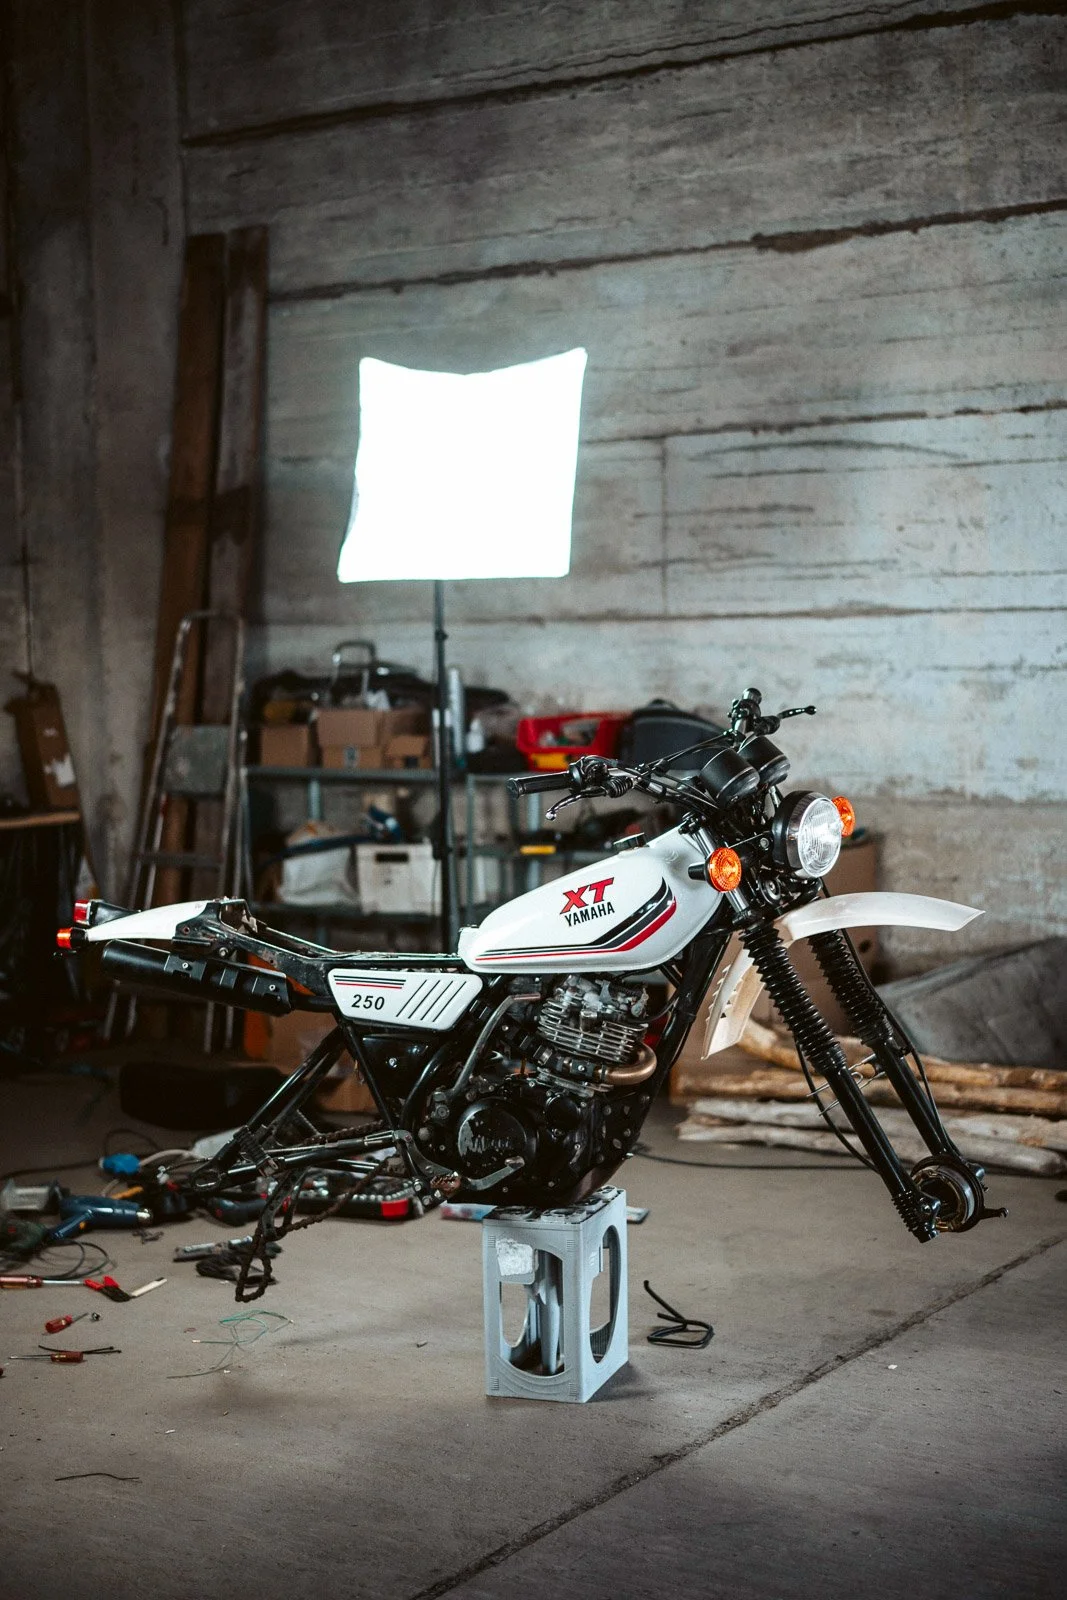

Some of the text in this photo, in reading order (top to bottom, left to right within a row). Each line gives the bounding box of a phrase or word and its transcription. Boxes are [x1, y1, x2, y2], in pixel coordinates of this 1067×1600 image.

[560, 877, 614, 914] XT
[564, 901, 615, 927] YAMAHA
[351, 994, 385, 1010] 250
